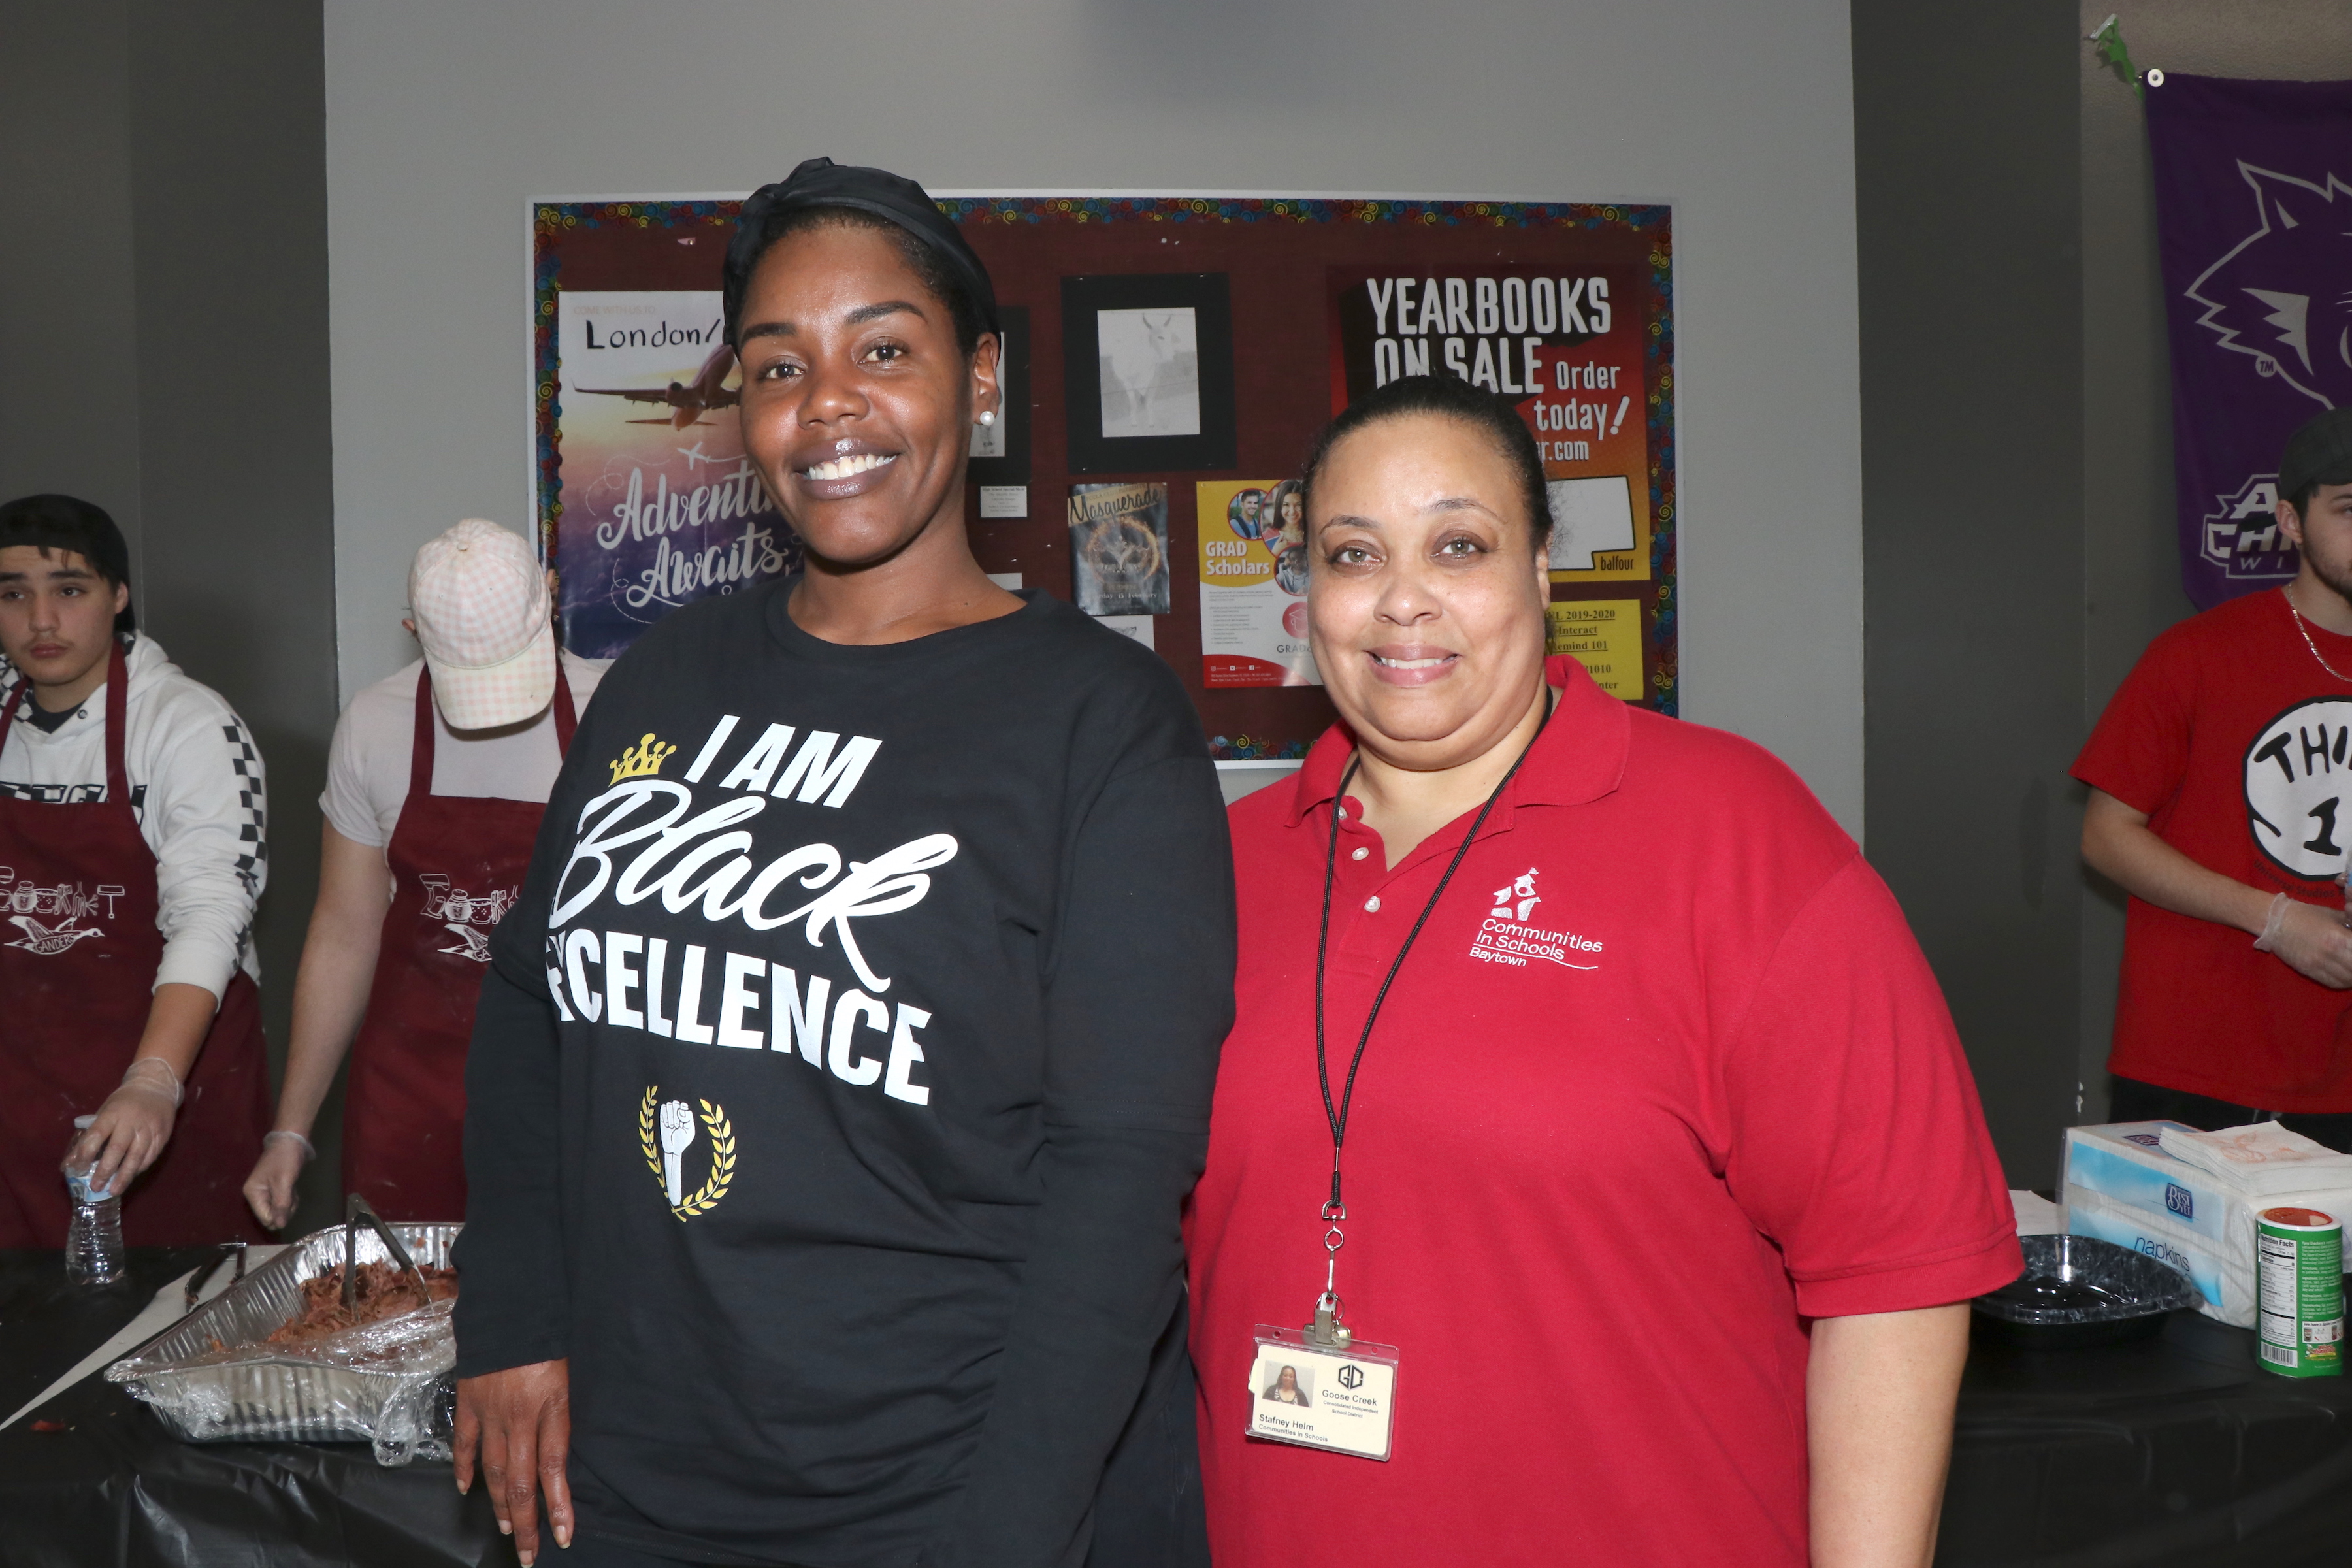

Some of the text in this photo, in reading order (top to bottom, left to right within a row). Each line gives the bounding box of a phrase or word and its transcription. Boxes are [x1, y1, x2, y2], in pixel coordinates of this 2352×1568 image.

[574, 306, 599, 315] COME
[602, 306, 625, 314] WITH
[644, 306, 656, 314] TO
[1367, 277, 1612, 335] YEARBOOKS
[1375, 337, 1544, 394] ON SALE
[2260, 360, 2274, 372] TM
[1556, 361, 1620, 391] Order
[1533, 396, 1630, 440] today!
[1070, 482, 1162, 523] Masquerade
[1205, 541, 1247, 557] GRAD
[1206, 559, 1270, 575] Scholars
[1601, 556, 1633, 570] balfour
[1566, 610, 1616, 620] 2019-2020
[1559, 626, 1597, 635] Interact
[1592, 641, 1607, 649] 101
[1595, 681, 1619, 689] nter
[684, 714, 883, 809] I AM
[2253, 723, 2352, 783] THI
[2303, 796, 2342, 856] 1
[548, 778, 958, 994] Black
[2253, 858, 2294, 891] Universal
[2296, 885, 2335, 898] Studios
[35, 933, 75, 953] GANDERS
[1482, 918, 1603, 953] Communities
[1469, 947, 1527, 967] Baytown
[1496, 935, 1565, 960] Schools
[546, 928, 932, 1106] XCELLENCE
[2179, 1205, 2191, 1216] YET
[2134, 1236, 2190, 1272] napkins
[1322, 1389, 1378, 1407] Goose Creek
[1323, 1400, 1379, 1414] Consolidated Independent
[1259, 1414, 1314, 1431] Stafney Helm
[1258, 1424, 1296, 1437] Communities
[1304, 1433, 1328, 1443] Schools
